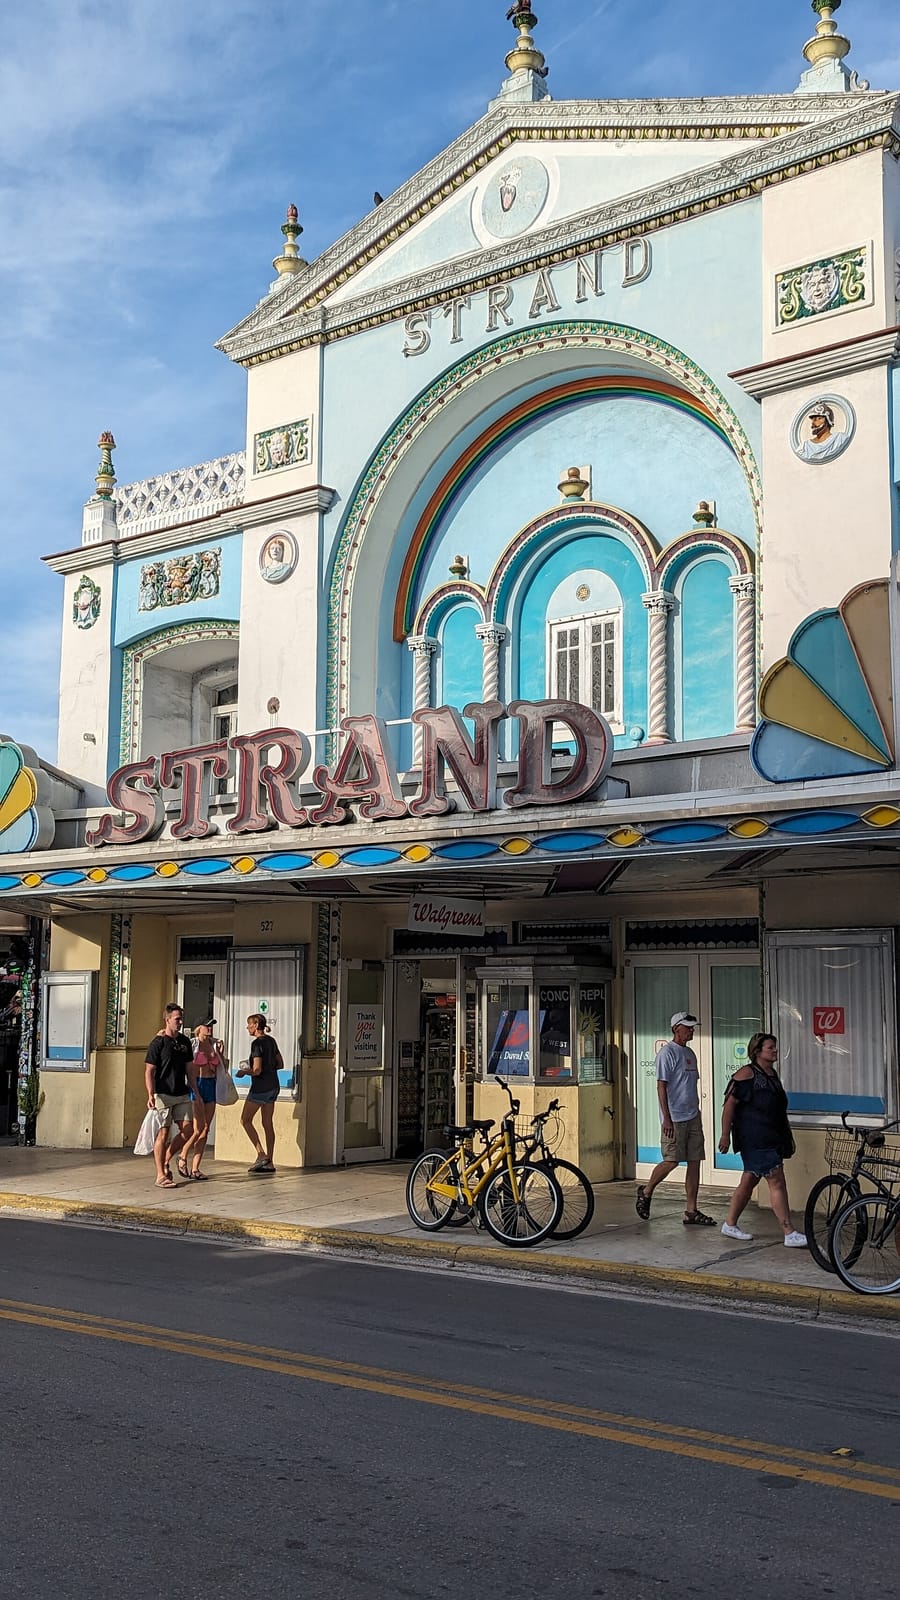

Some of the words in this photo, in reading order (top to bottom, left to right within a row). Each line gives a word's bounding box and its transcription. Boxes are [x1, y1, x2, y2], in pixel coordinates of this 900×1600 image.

[402, 237, 653, 358] STRAND
[85, 699, 614, 847] STRAND
[413, 903, 483, 930] Walgreens
[356, 1012, 376, 1020] Thank
[355, 1022, 376, 1043] you
[362, 1031, 372, 1040] for
[354, 1042, 377, 1052] visiting
